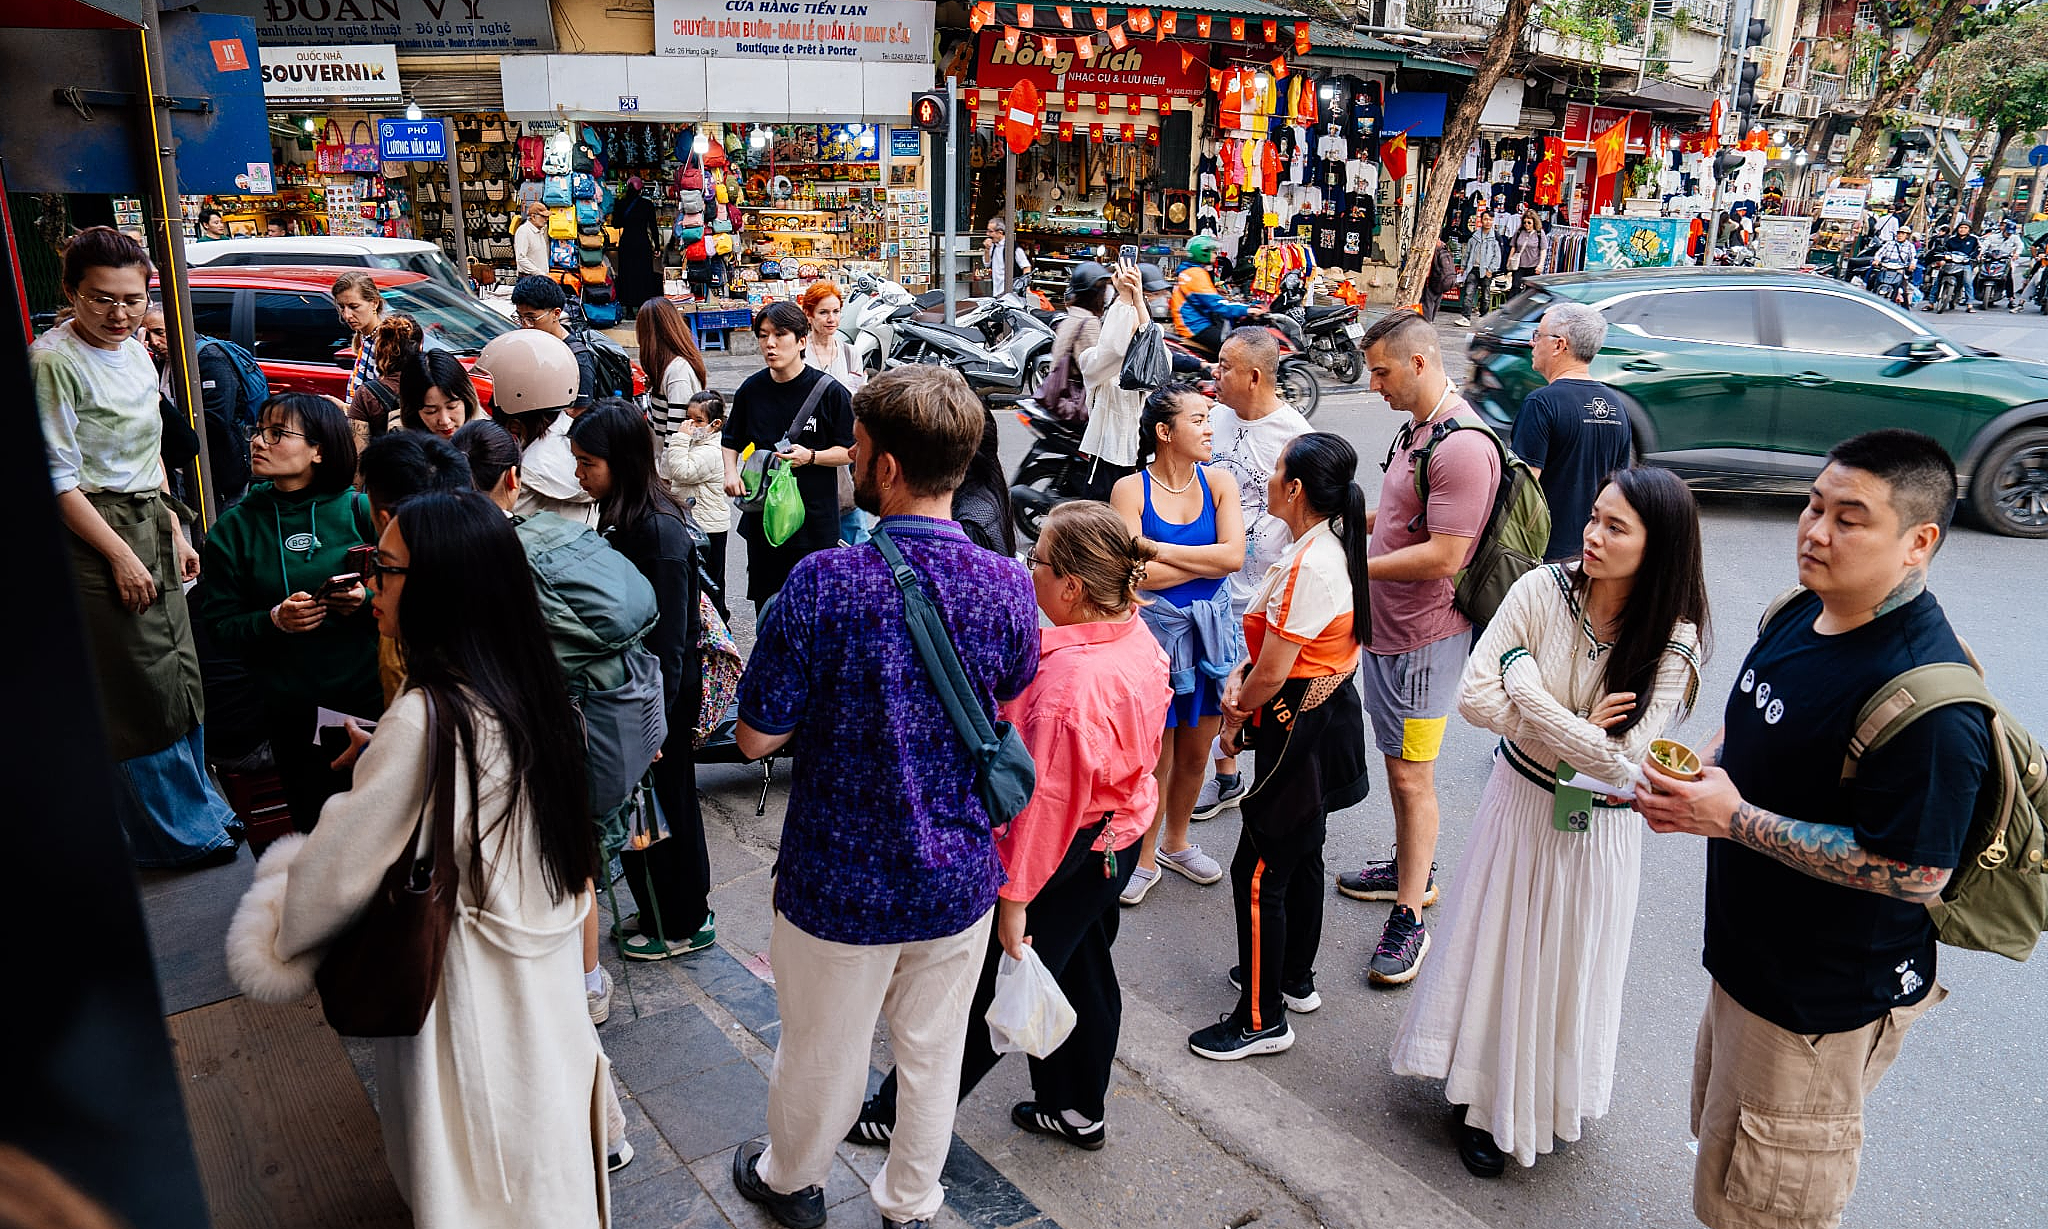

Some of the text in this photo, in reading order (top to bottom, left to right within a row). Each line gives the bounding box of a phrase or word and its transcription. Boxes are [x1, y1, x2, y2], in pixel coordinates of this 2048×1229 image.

[840, 5, 868, 16] LAN
[316, 25, 334, 38] tay
[673, 16, 716, 37] CHUYÊN
[718, 18, 741, 38] BÁN
[743, 19, 772, 39] BUÔN
[848, 22, 862, 42] ÁO
[864, 26, 887, 43] MAY
[736, 42, 858, 56] Boutique de Prêt à Porter
[262, 62, 386, 83] SOUVERNIR
[1068, 71, 1095, 82] NHẠC
[1097, 73, 1111, 85] CỤ
[1112, 75, 1119, 83] &
[1142, 74, 1166, 87] NIỆM
[622, 98, 635, 109] 26
[1049, 114, 1058, 122] 24
[407, 124, 428, 134] PHỐ
[386, 138, 441, 154] LƯƠNG VĂN CAN
